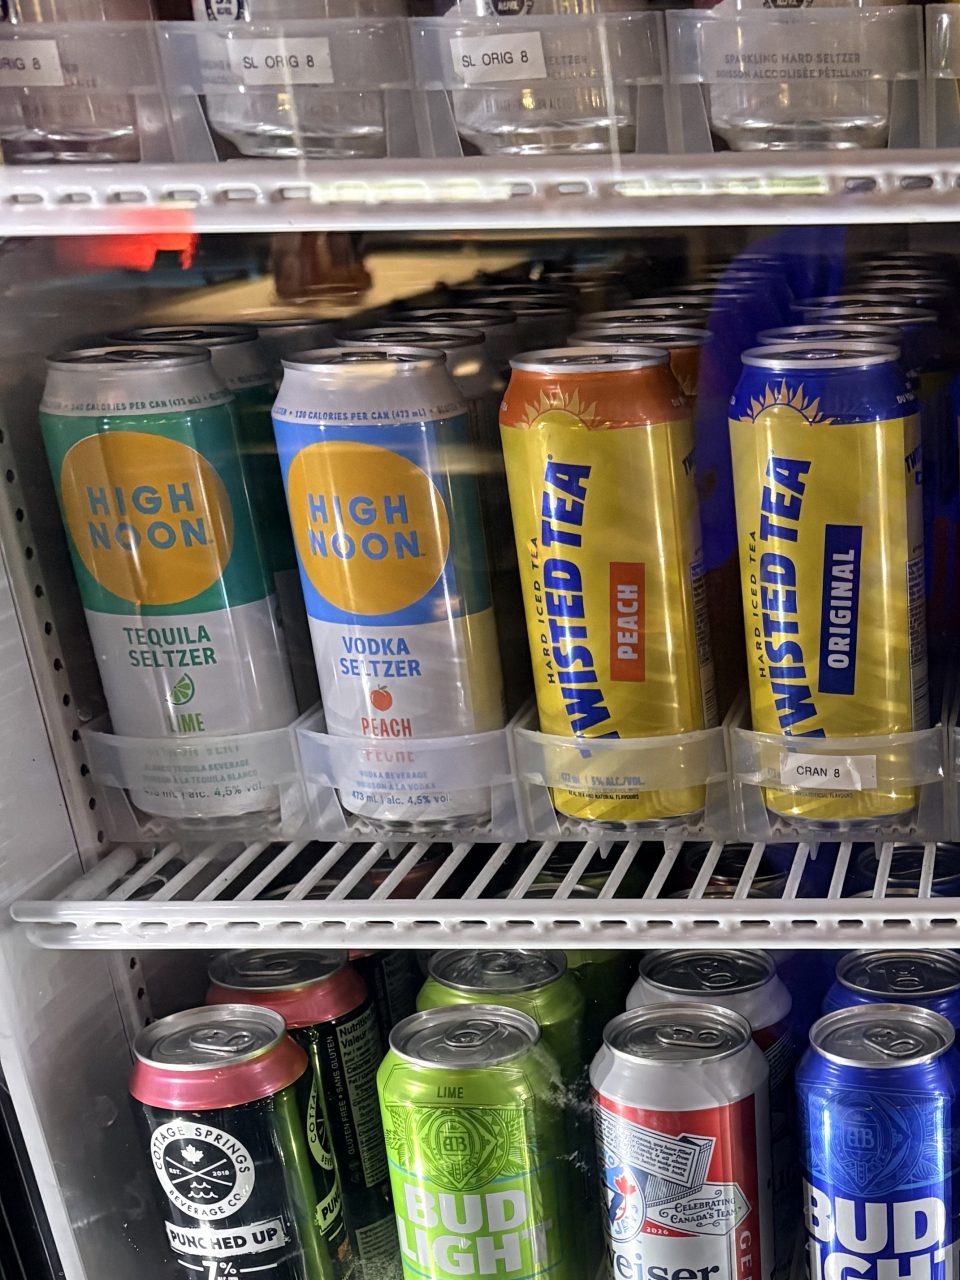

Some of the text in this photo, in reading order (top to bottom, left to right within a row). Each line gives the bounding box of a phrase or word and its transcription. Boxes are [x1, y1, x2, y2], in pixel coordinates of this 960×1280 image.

[33, 57, 41, 70] 8
[243, 55, 315, 69] SL ORIG 8
[462, 50, 529, 67] SL ORIG 8
[725, 52, 860, 65] SPARKLING HARD SELTZER
[308, 411, 367, 422] CALORIES PER
[87, 482, 195, 516] HIGH
[307, 493, 409, 526] HIGH
[541, 461, 592, 548] TEA
[760, 456, 813, 544] TEA
[87, 517, 208, 552] NOON
[309, 529, 420, 561] NOON
[531, 536, 557, 685] HARD ICED TEA
[748, 530, 767, 679] HARD ICED TEA
[827, 548, 855, 671] ORIGINAL
[616, 583, 639, 661] PEACH
[123, 625, 212, 646] TEQUILA
[341, 635, 411, 657] VODKA
[128, 647, 218, 668] SELTZER
[339, 657, 422, 678] SELTZER
[168, 713, 206, 733] LIME
[361, 716, 413, 738] PEACH
[796, 765, 841, 778] CRAN 8
[325, 1036, 339, 1068] GLUTEN
[436, 1085, 464, 1100] LIME
[153, 1125, 251, 1174] COTTAGE SPRINGS
[168, 1189, 226, 1217] BEVERAGE
[403, 1183, 528, 1235] BUD
[674, 1197, 736, 1214] CELEBRATING
[670, 1211, 714, 1225] CANADA'S
[802, 1177, 947, 1254] BUD
[251, 1228, 278, 1245] UP
[646, 1226, 669, 1236] 2026
[397, 1215, 551, 1277] LIGHT
